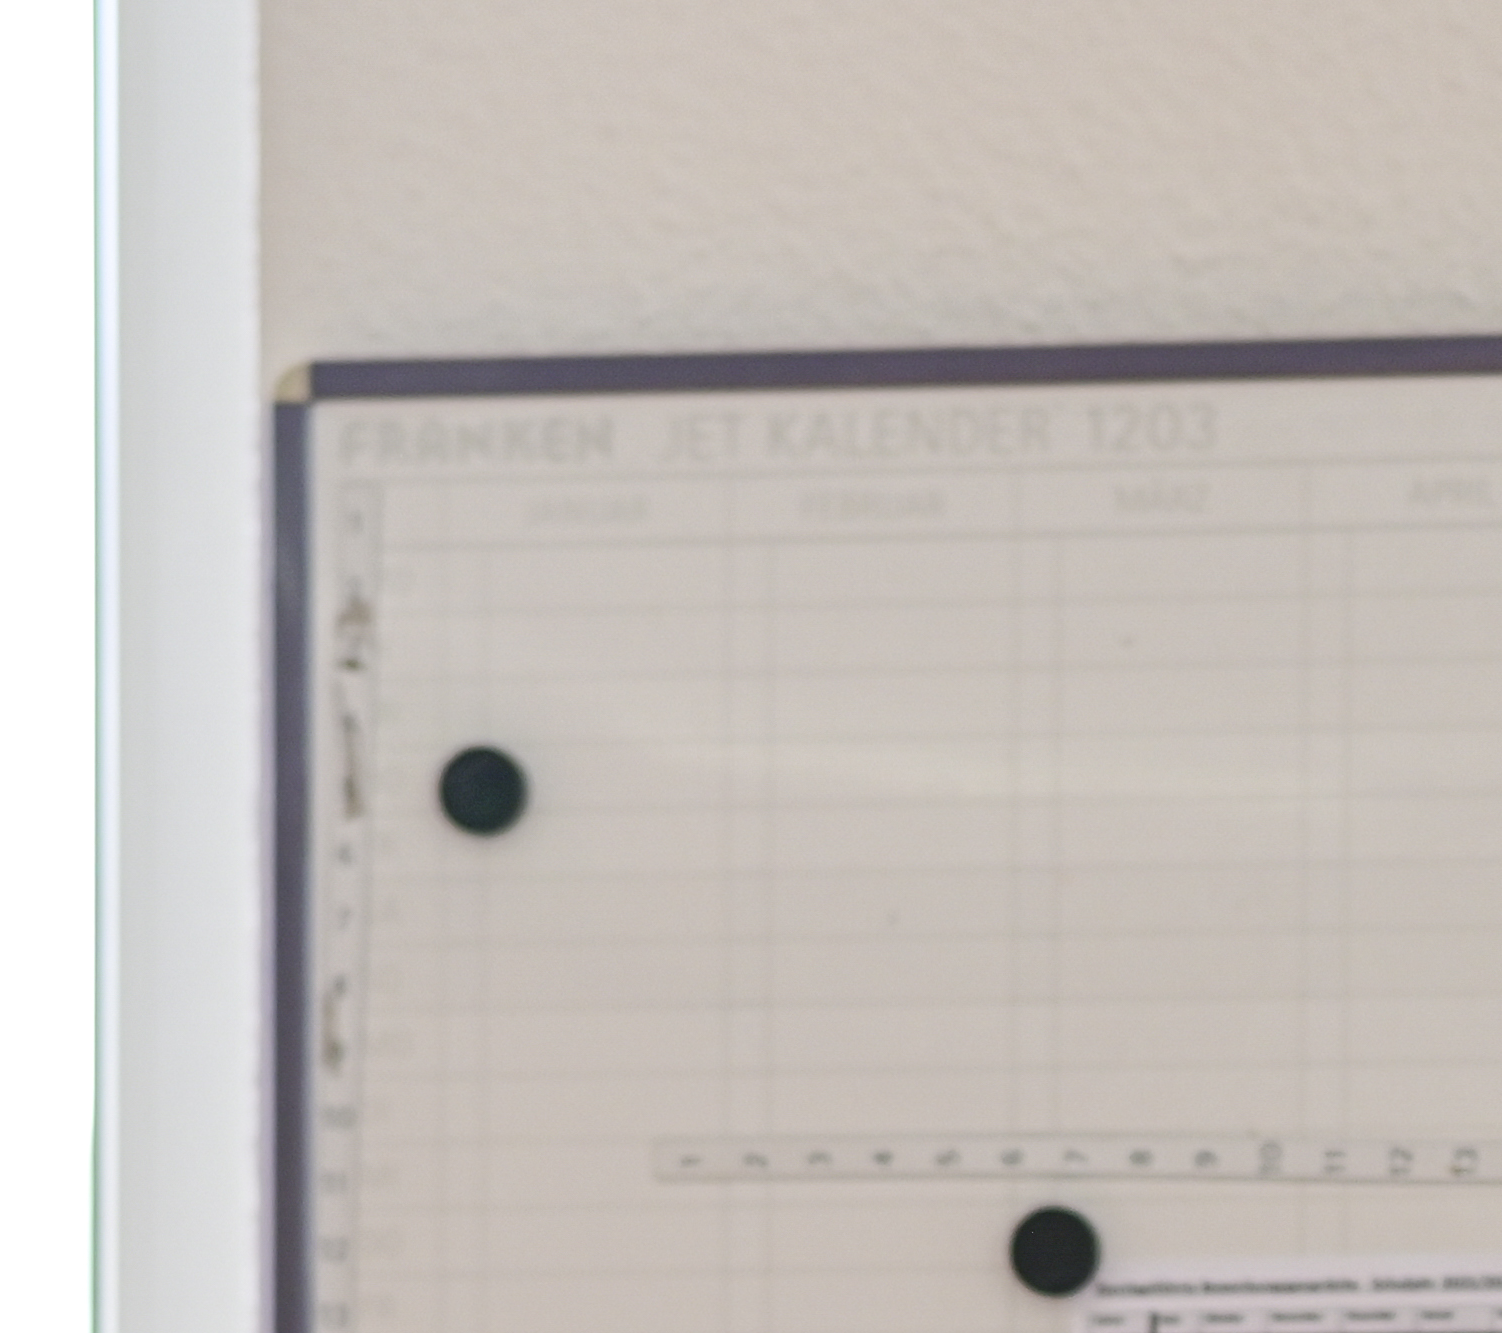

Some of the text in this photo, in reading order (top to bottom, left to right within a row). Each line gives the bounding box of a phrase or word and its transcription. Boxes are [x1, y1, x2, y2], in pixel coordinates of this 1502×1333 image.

[339, 402, 1218, 466] FRANKEN JET KALENDER 1203
